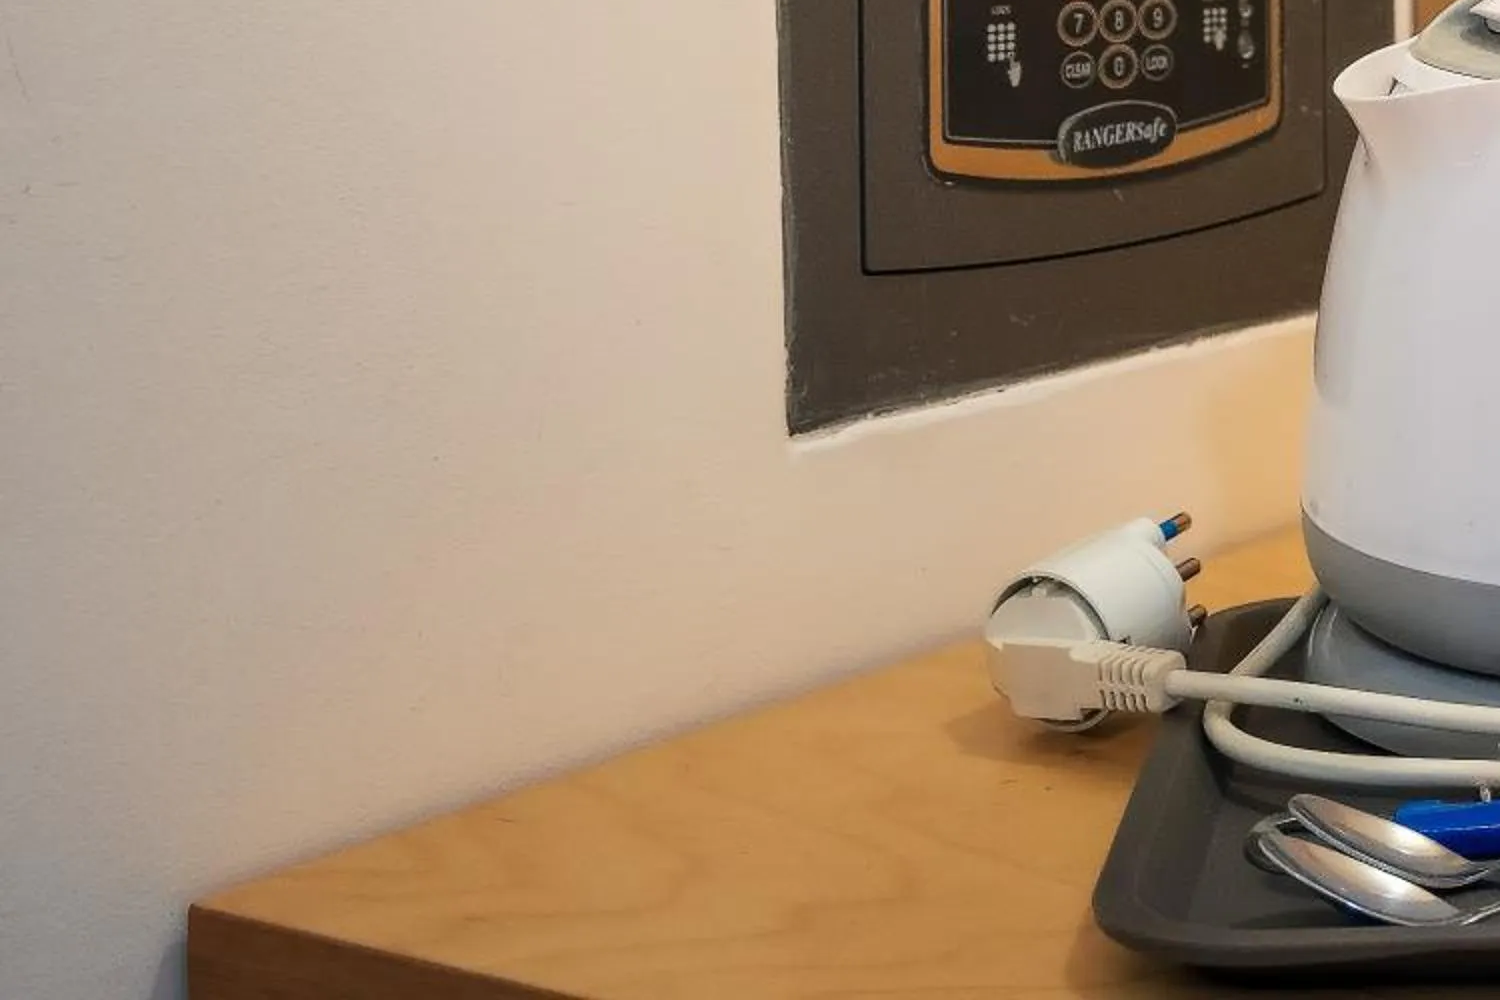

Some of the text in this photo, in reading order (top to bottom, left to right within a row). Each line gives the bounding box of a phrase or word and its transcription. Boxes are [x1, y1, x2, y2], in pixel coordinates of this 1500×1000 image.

[1072, 7, 1163, 34] 7 8 9
[1113, 56, 1124, 78] 0
